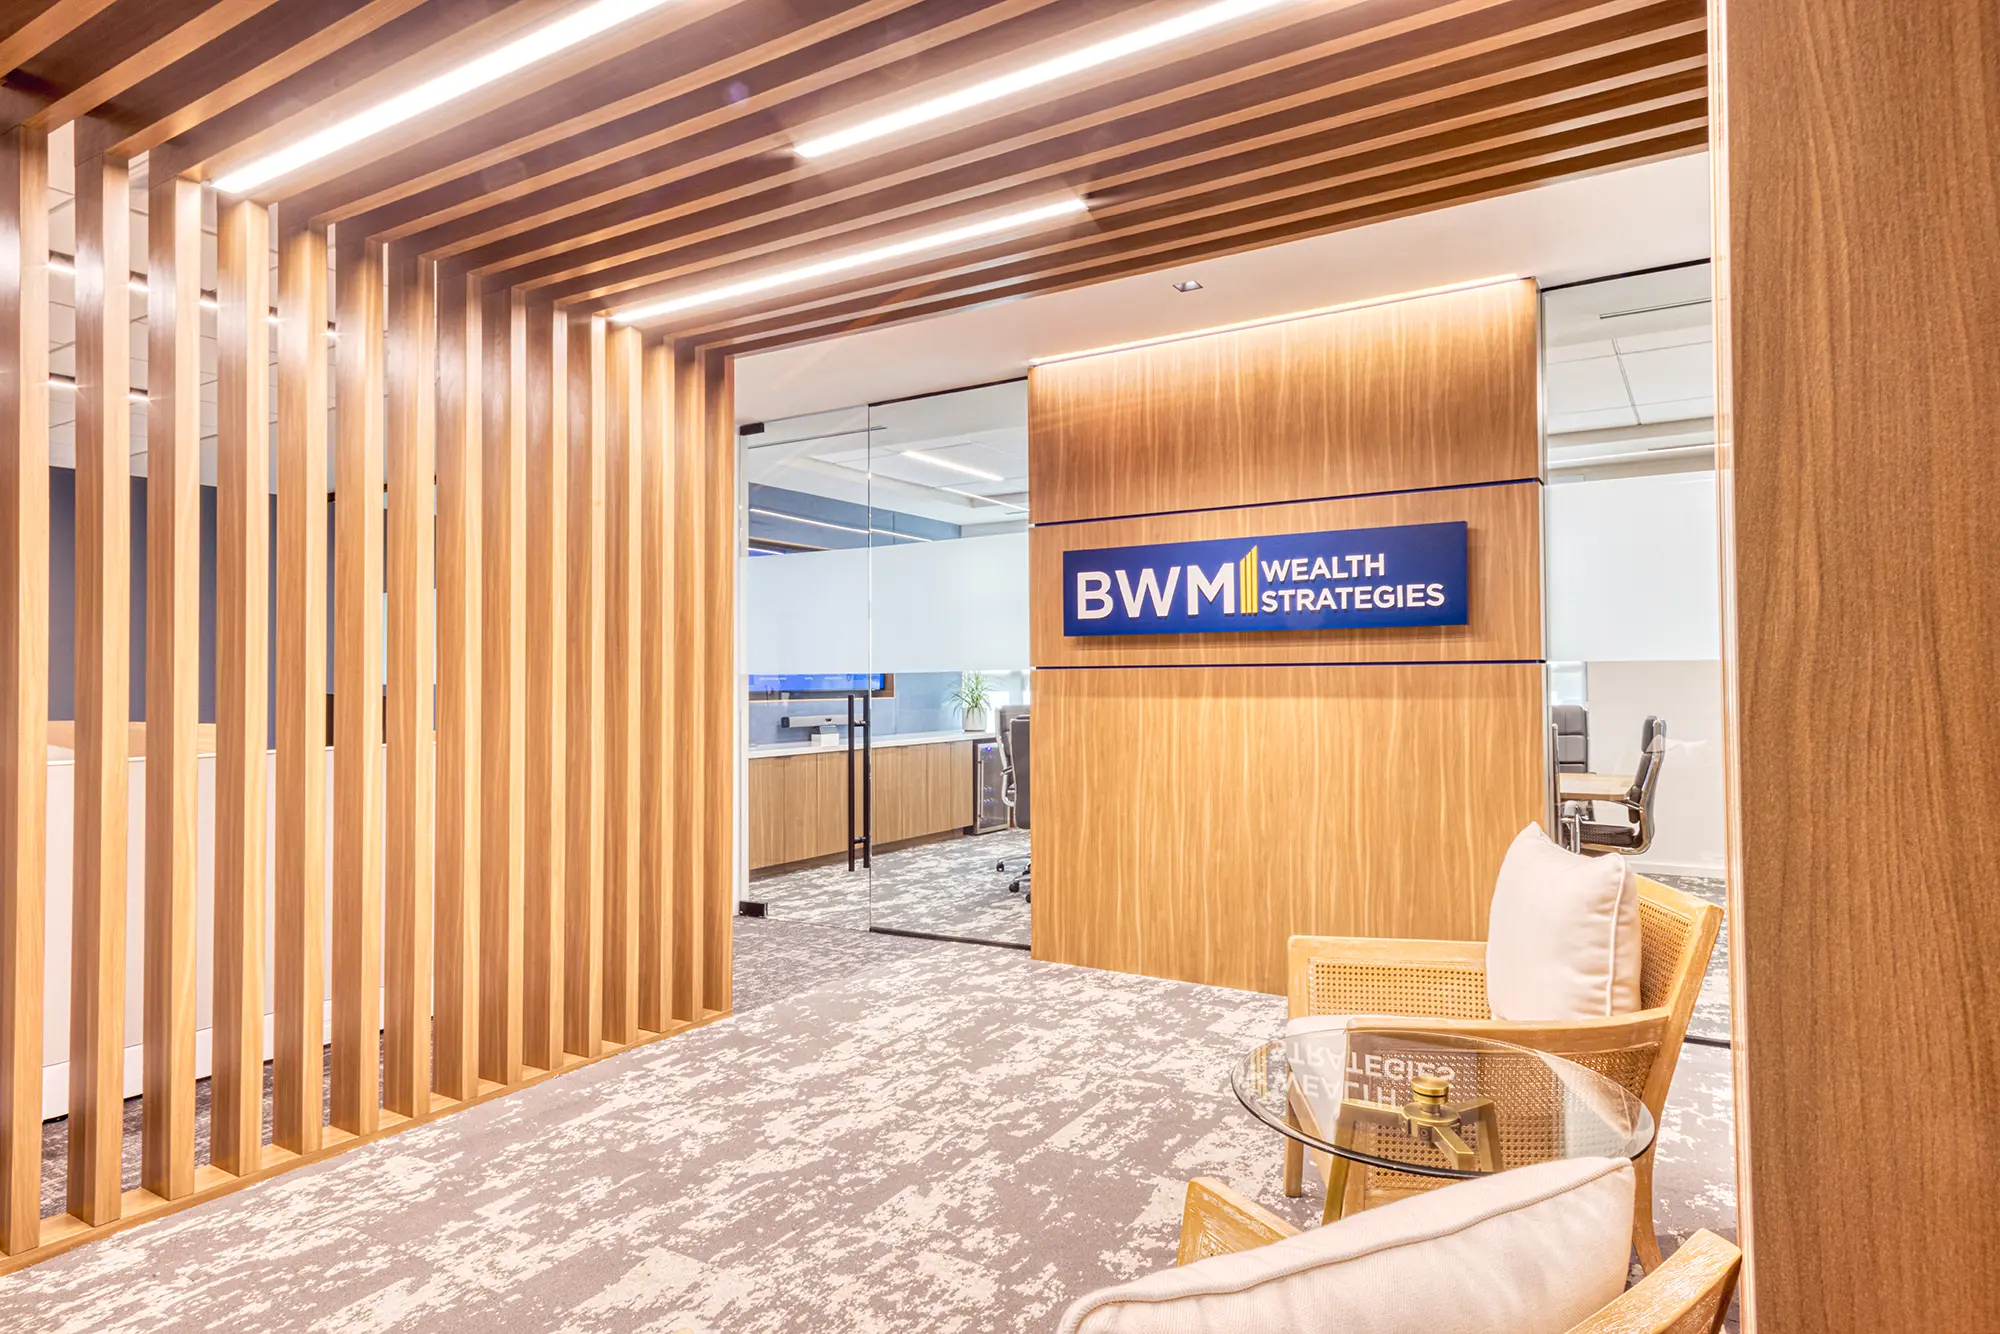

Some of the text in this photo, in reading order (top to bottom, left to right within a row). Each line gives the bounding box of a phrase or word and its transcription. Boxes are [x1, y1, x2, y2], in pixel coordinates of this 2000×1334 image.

[1261, 553, 1385, 583] WEALTH
[1077, 562, 1235, 619] BWM
[1261, 583, 1445, 613] STRATEGIES
